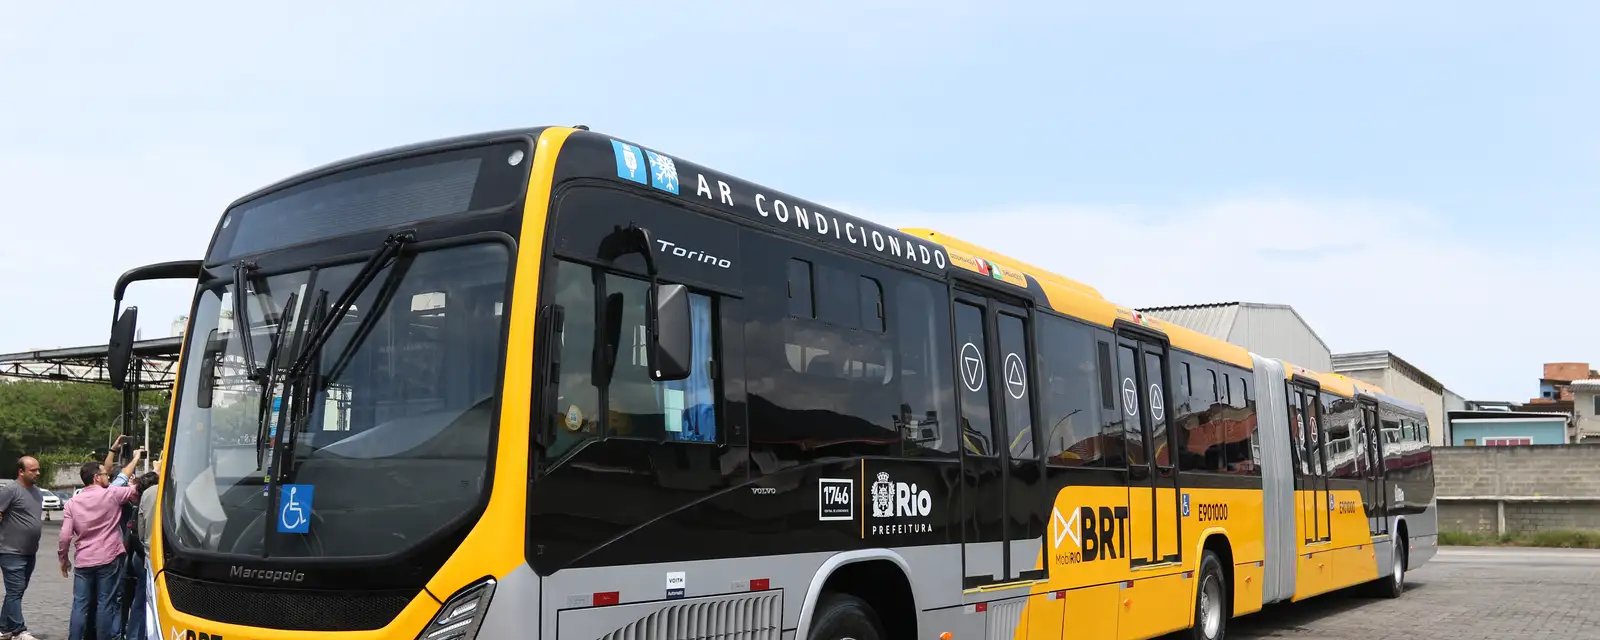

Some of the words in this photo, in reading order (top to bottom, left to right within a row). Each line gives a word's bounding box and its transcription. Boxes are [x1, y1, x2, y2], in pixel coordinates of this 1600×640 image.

[697, 173, 734, 206] AR
[755, 193, 946, 269] CONDICIONADO
[656, 239, 732, 269] Torino
[824, 486, 849, 504] 1746
[896, 482, 932, 516] Rio
[1198, 503, 1228, 521] E901000
[872, 523, 932, 535] PREFEITURA
[1081, 506, 1128, 562] BRT
[230, 565, 304, 582] Marcopolo
